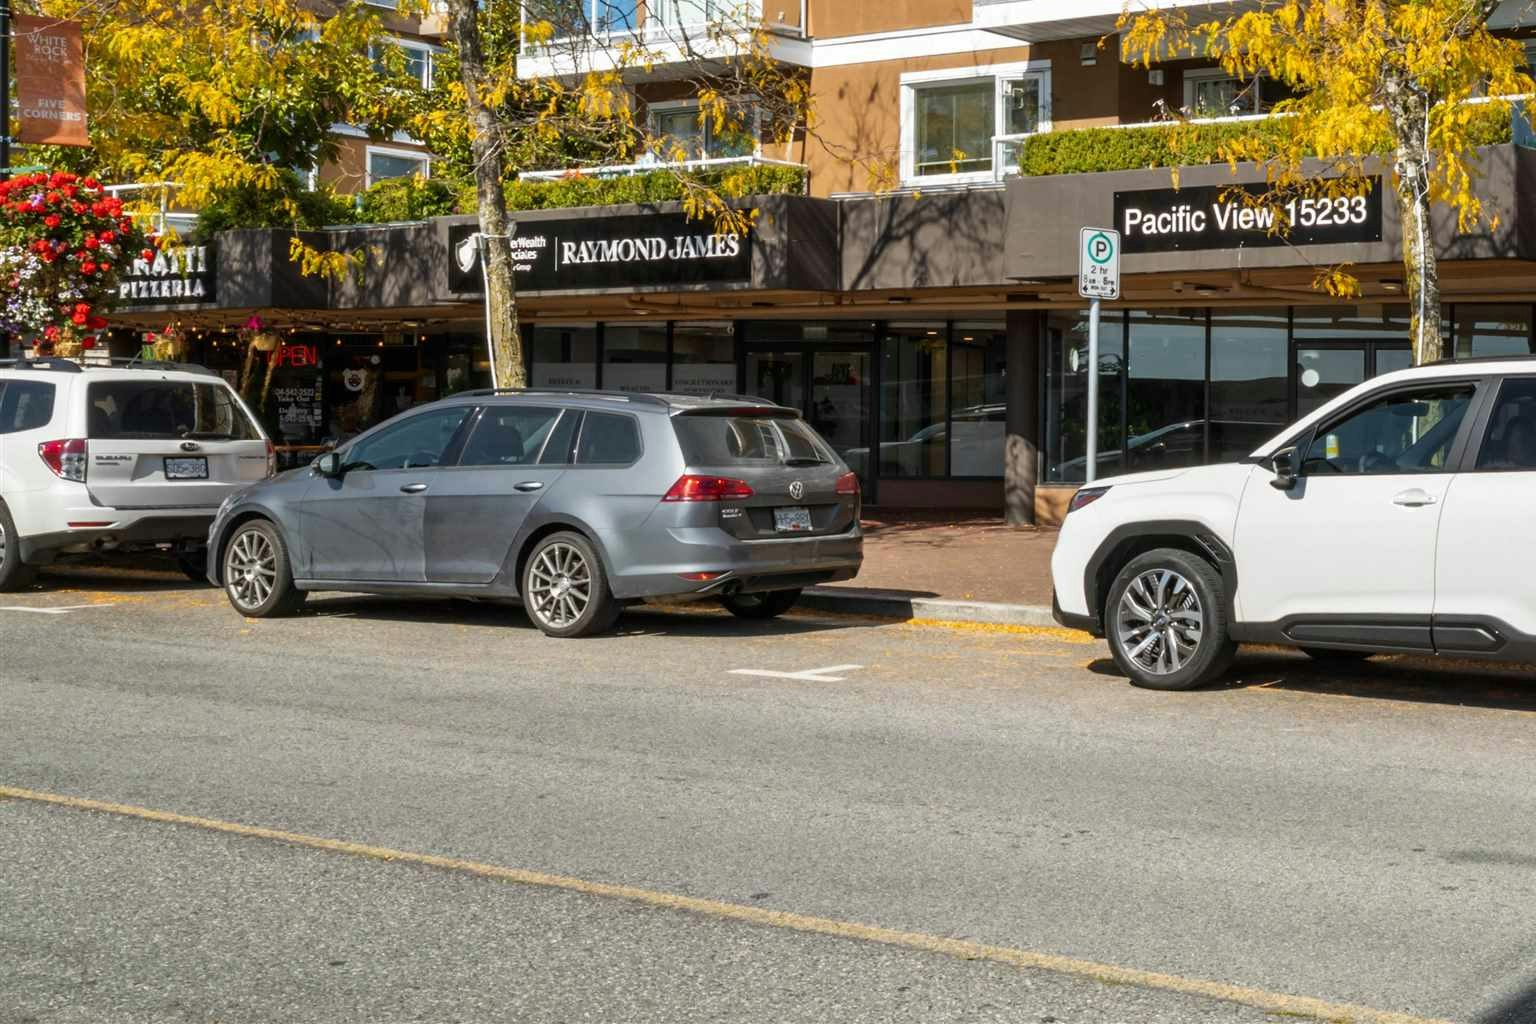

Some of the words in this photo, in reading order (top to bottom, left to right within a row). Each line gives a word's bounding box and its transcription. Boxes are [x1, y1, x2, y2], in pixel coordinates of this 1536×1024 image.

[27, 32, 67, 48] WHITE
[34, 45, 68, 57] ROCK
[38, 98, 65, 109] FIVE
[23, 108, 82, 122] CORNERS
[1123, 205, 1207, 236] Pacific
[1212, 202, 1275, 231] View
[1285, 195, 1368, 227] 15233
[509, 234, 547, 249] erWealth
[561, 238, 667, 265] RAYMOND
[668, 233, 740, 260] JAMES
[1096, 241, 1107, 257] P
[1090, 265, 1097, 275] 2
[1100, 266, 1109, 275] hr
[119, 279, 206, 299] PIZZERIA
[268, 344, 317, 367] PEN
